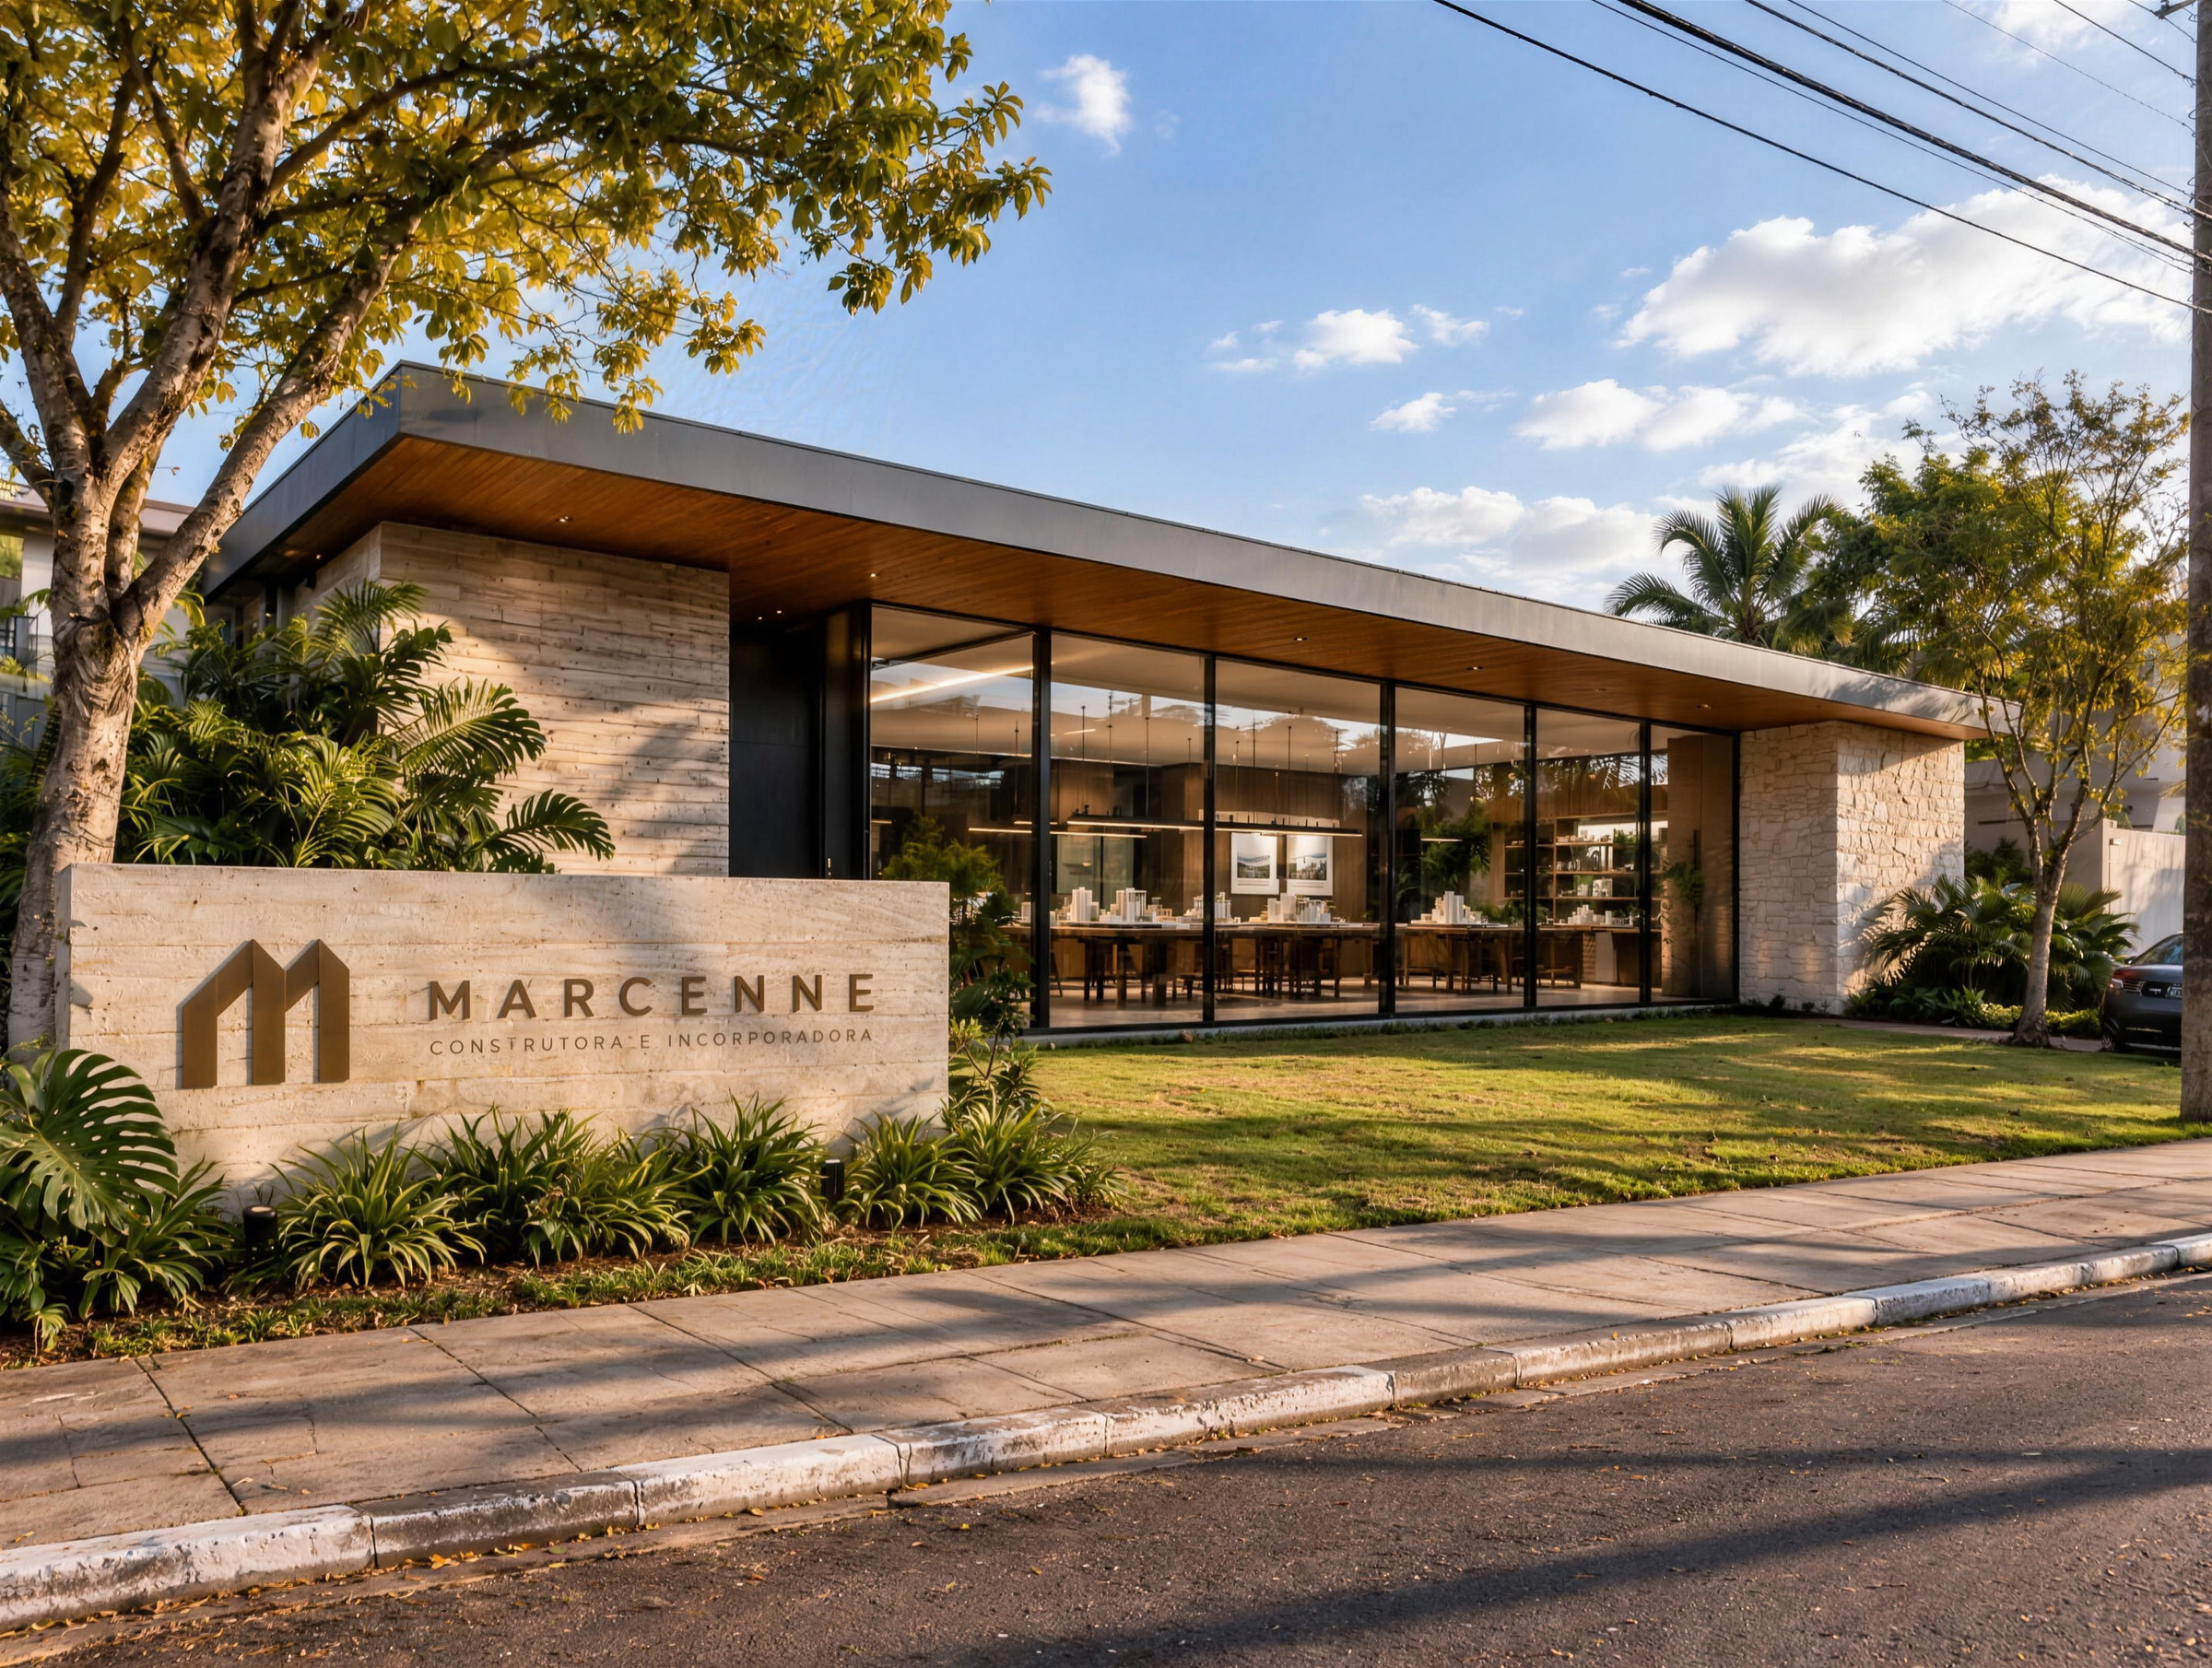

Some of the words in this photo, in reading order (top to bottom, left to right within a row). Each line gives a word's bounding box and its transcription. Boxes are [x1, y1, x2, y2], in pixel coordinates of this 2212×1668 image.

[429, 973, 875, 1020] MARCENNE
[429, 1035, 623, 1055] CONSTRUTORA
[641, 1034, 651, 1049] E
[668, 1028, 872, 1047] INCORPORADORA
